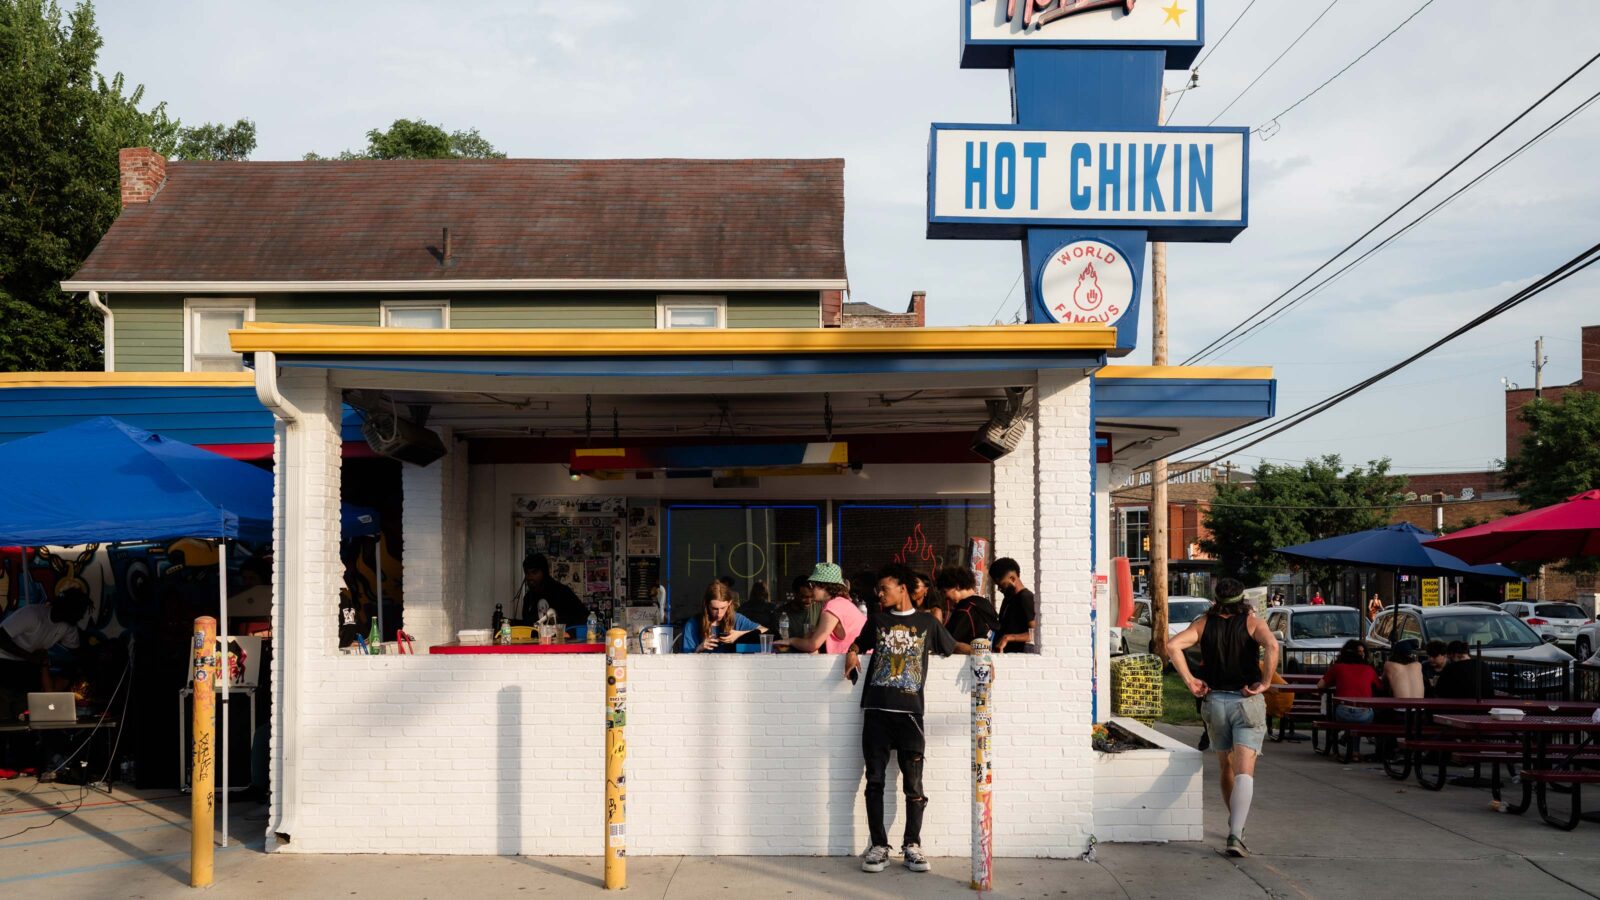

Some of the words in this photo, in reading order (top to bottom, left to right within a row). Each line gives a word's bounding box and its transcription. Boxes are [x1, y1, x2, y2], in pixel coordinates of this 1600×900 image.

[965, 141, 1047, 210] HOT
[1070, 143, 1214, 213] CHIKIN
[1057, 245, 1117, 267] WORLD
[1055, 303, 1120, 324] FAMOUS
[1139, 472, 1151, 485] AR
[688, 542, 801, 578] HOT
